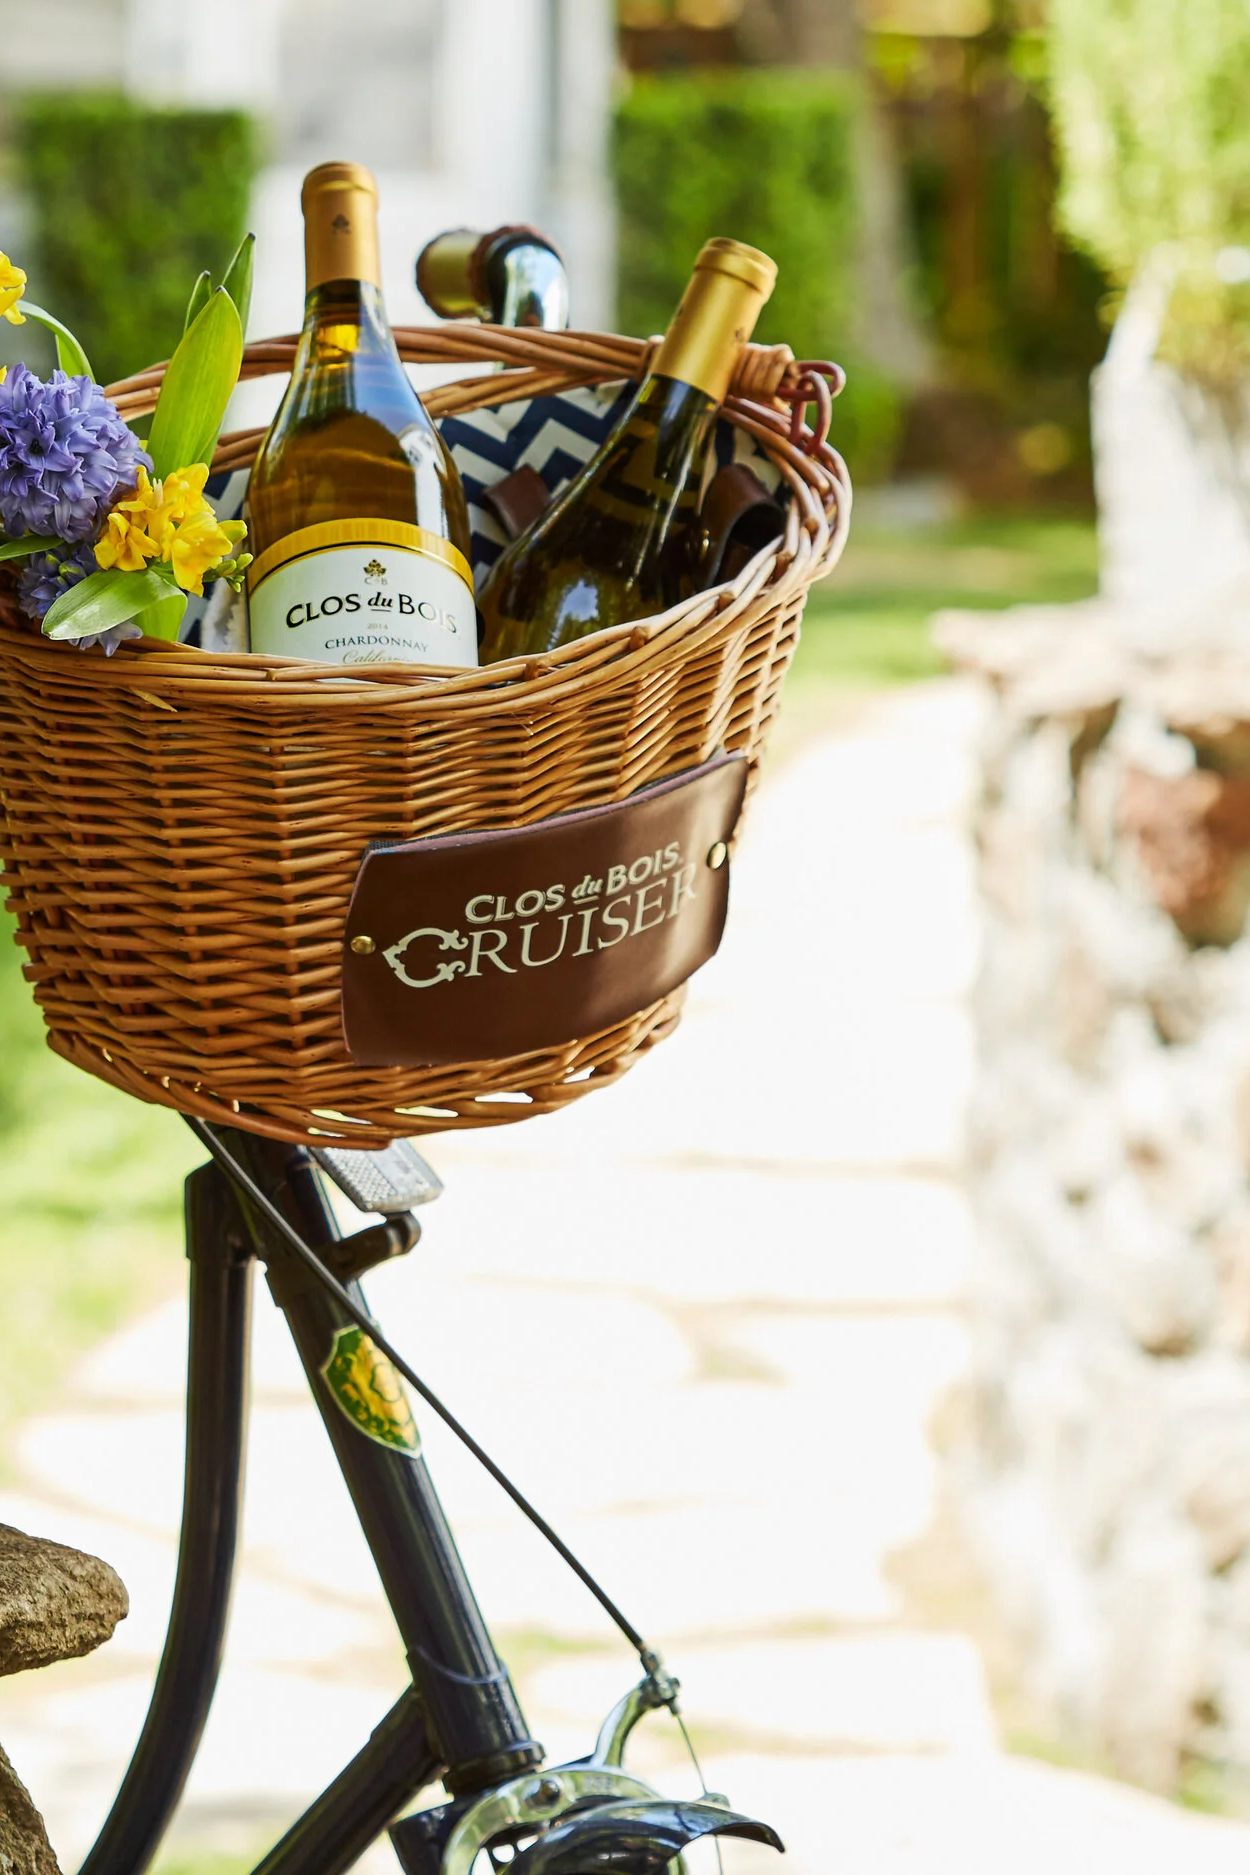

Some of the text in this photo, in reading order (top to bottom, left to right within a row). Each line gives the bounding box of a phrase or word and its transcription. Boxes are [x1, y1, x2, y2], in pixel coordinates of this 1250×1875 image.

[285, 591, 457, 634] CLOS du BOIS
[325, 635, 429, 653] CHARDONNAY
[464, 841, 679, 925] CLOS du BOIS
[381, 862, 698, 988] CRUISER
